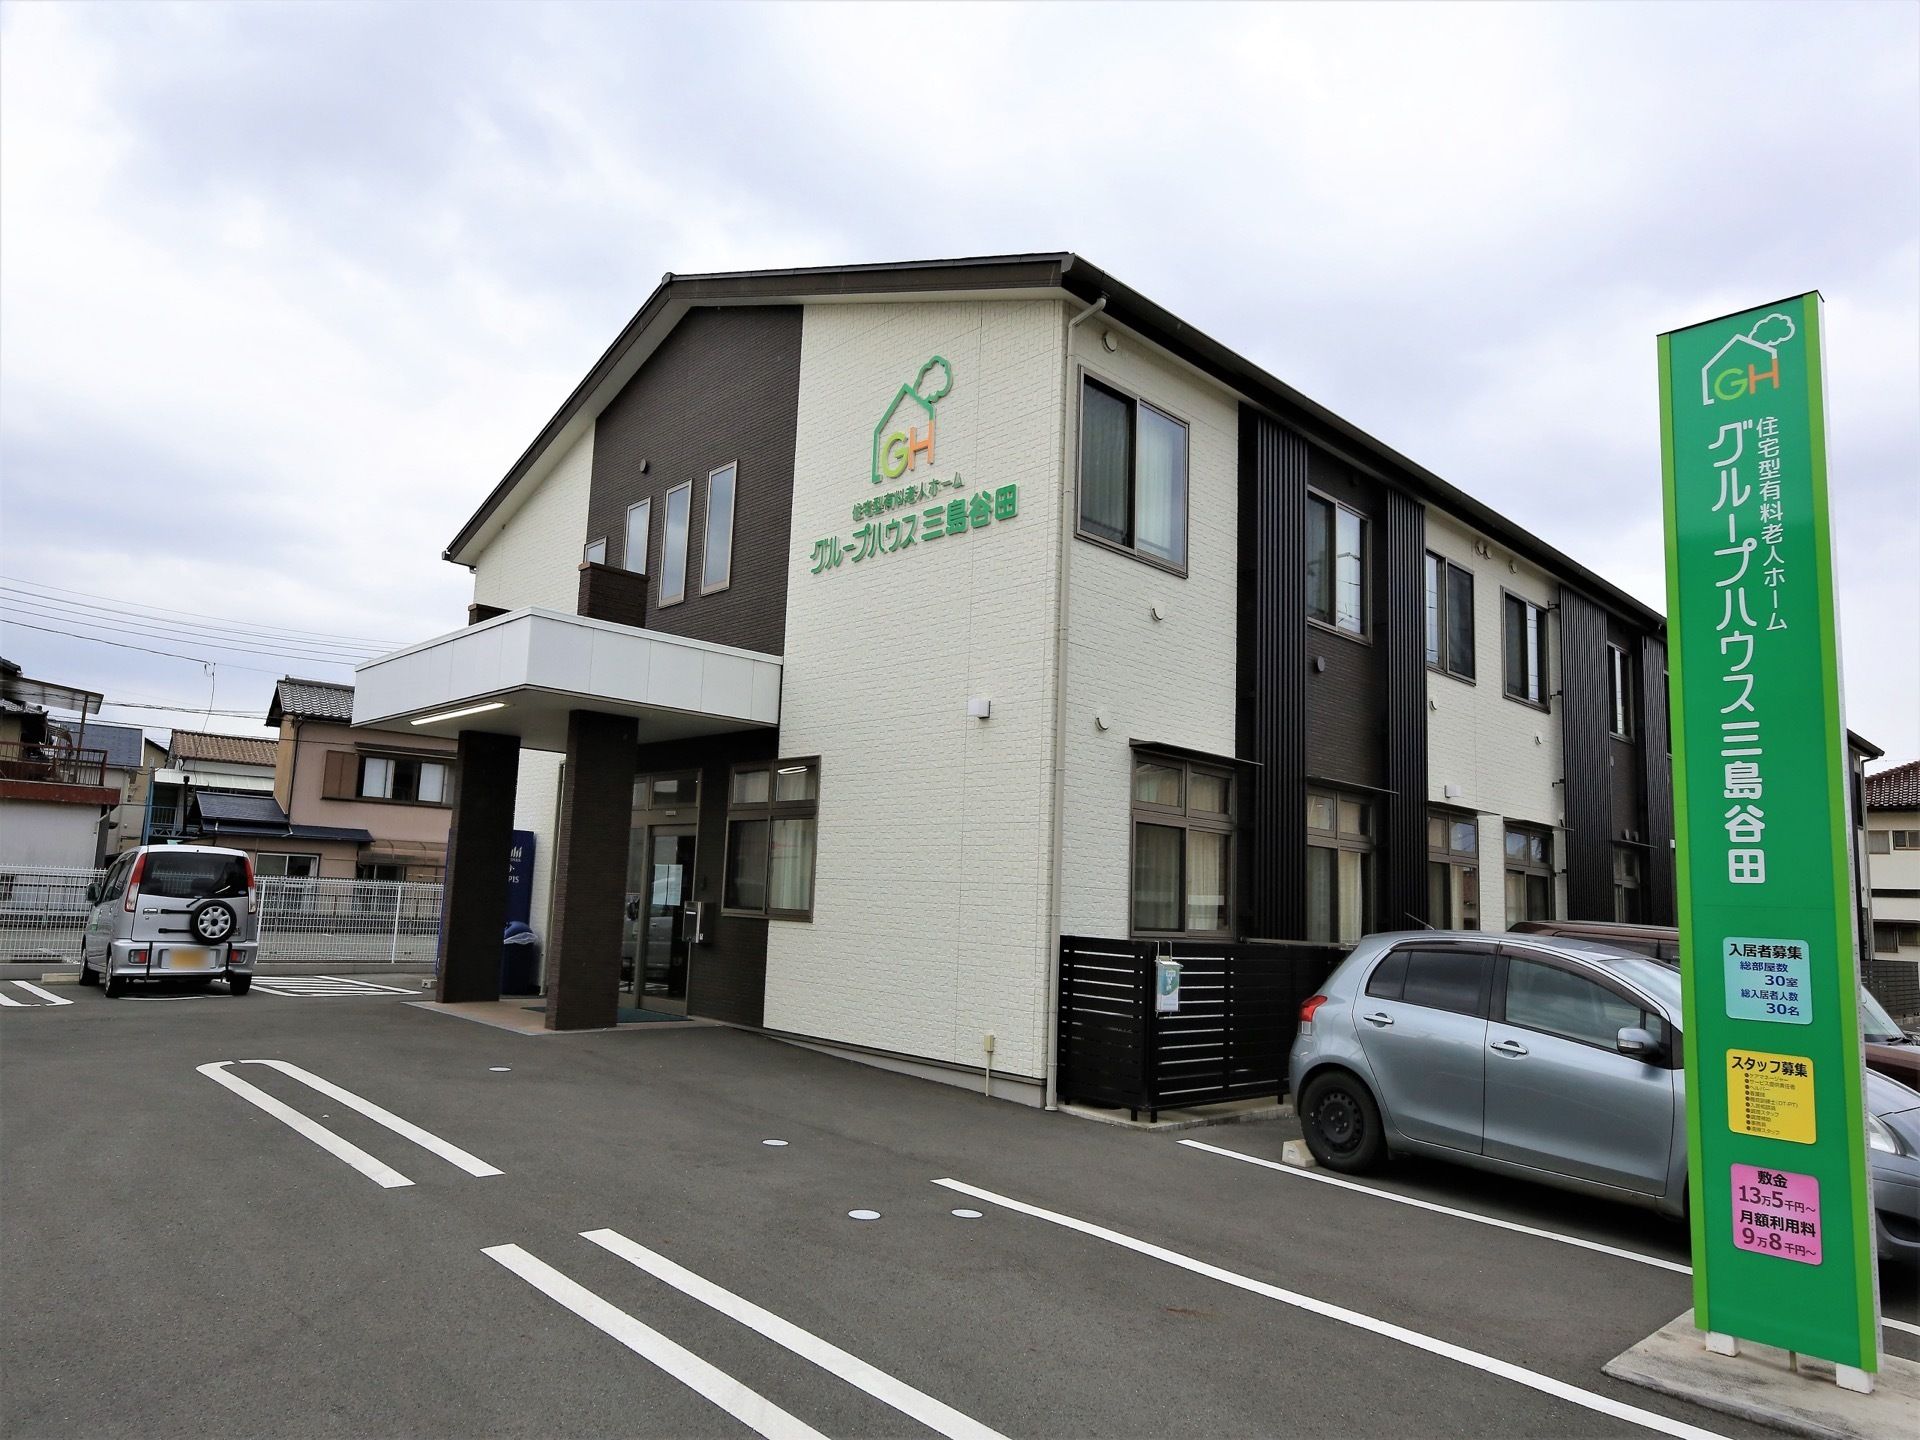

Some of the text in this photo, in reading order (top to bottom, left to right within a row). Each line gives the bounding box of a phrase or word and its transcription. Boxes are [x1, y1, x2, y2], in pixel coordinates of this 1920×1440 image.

[1714, 358, 1780, 400] GH
[881, 420, 935, 478] GH
[810, 483, 1019, 574] グループハウス三島谷田
[1756, 416, 1788, 631] 住宅型有料老人ホーム
[1708, 419, 1766, 884] グループハウス三島谷田
[1729, 943, 1803, 960] 入居者募集
[1740, 961, 1788, 973] 総部屋数
[1765, 975, 1799, 988] 30室
[1741, 988, 1799, 1002] 総入居者人数
[1766, 1003, 1800, 1017] 30名
[1731, 1056, 1808, 1078] スタッフ募集
[1758, 1170, 1788, 1189] 敷金
[1740, 1210, 1816, 1238] 月額利用料
